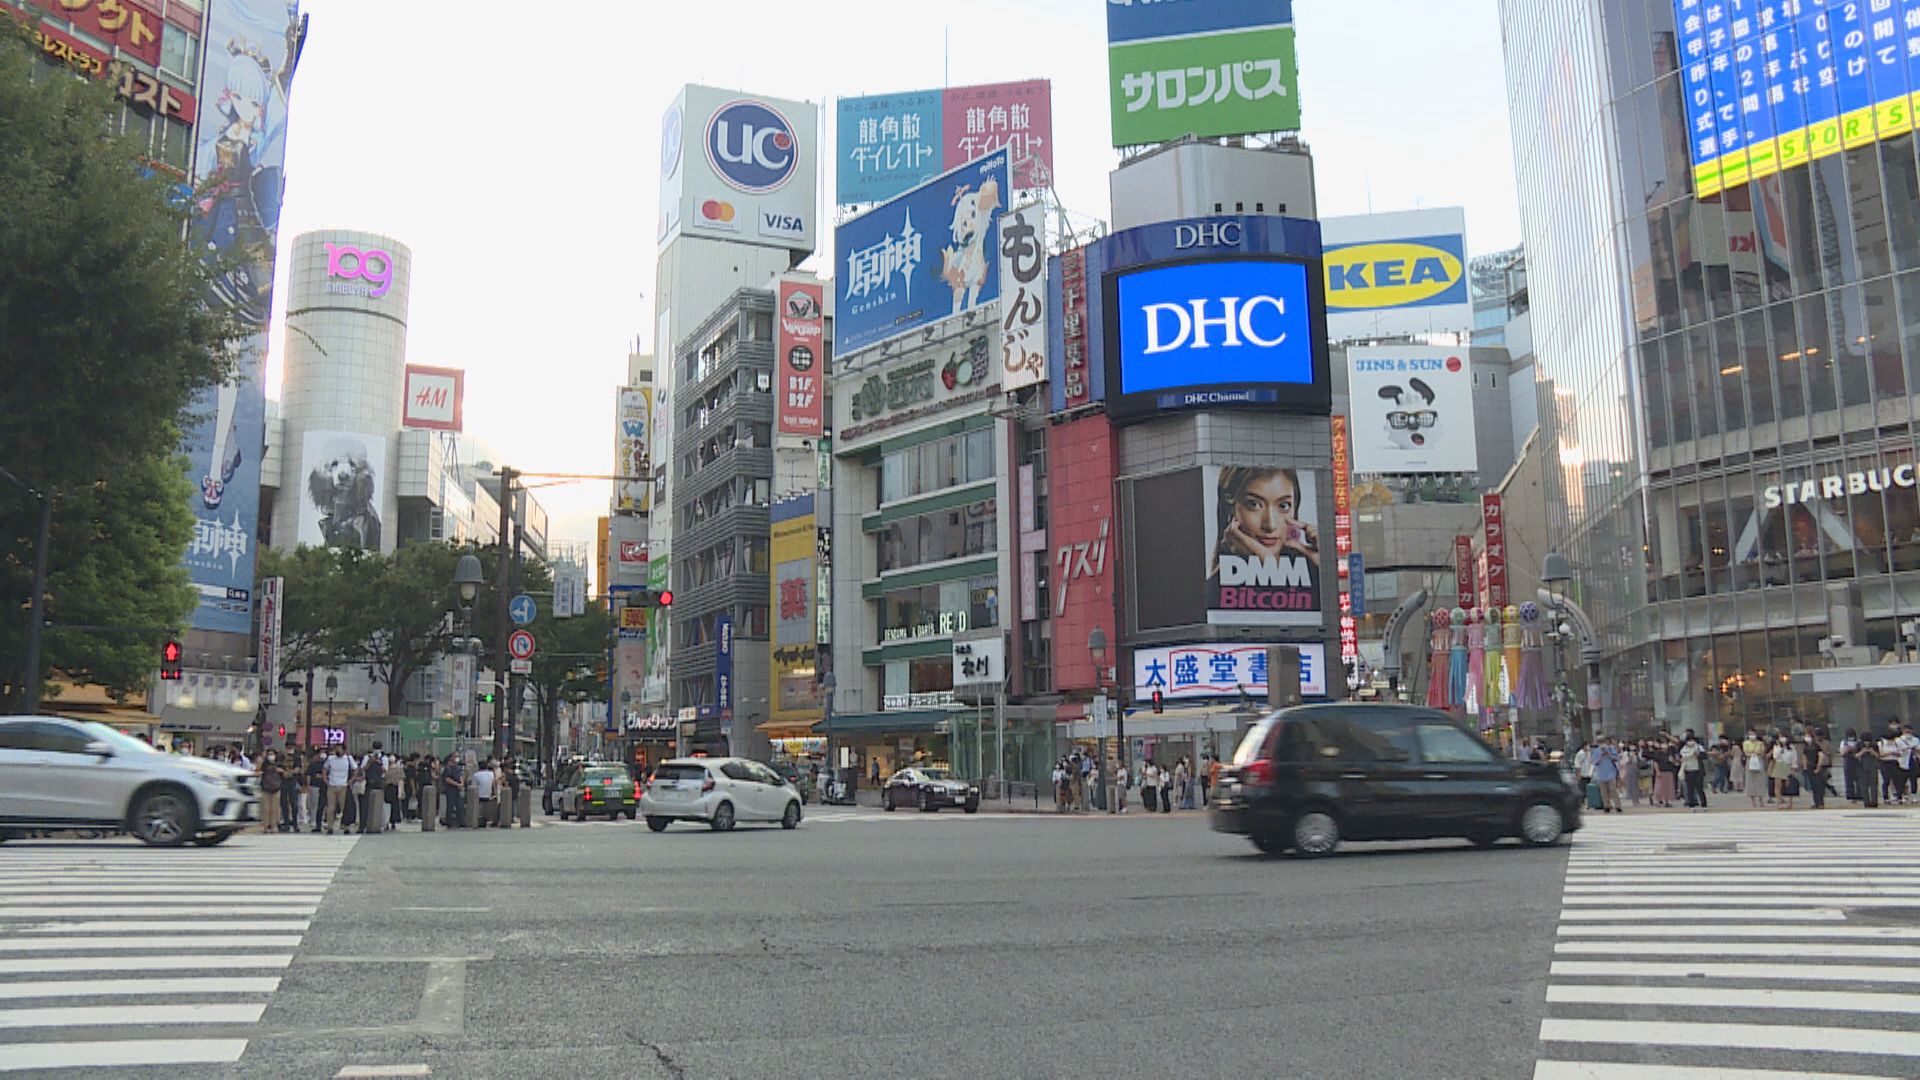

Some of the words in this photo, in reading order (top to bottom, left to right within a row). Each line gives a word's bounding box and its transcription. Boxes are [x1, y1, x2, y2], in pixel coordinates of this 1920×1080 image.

[1121, 58, 1287, 112] サロンパス
[859, 113, 921, 145] 龍角散
[966, 103, 1030, 134] 龍角散
[1782, 105, 1904, 159] SPORTS
[717, 119, 789, 170] UC
[850, 141, 933, 173] ダイレクト
[764, 213, 803, 232] VISA
[1174, 221, 1242, 249] DHC
[324, 243, 393, 298] 109
[845, 205, 922, 305] 原神
[851, 292, 897, 315] Genshin
[1001, 212, 1044, 378] もんじゃ
[1141, 294, 1287, 354] DHC
[1356, 360, 1395, 372] JINS
[1410, 359, 1443, 371] SUN
[789, 376, 813, 391] B1F
[1185, 393, 1208, 405] DHC
[1209, 391, 1249, 403] Channel
[788, 392, 814, 408] B2F
[1764, 463, 1920, 509] STARBUC
[1485, 504, 1503, 576] カラオケ
[1055, 516, 1110, 617] クスリ
[1219, 554, 1312, 587] DMM
[1220, 587, 1312, 608] Bitcoin
[961, 655, 989, 678] 松川
